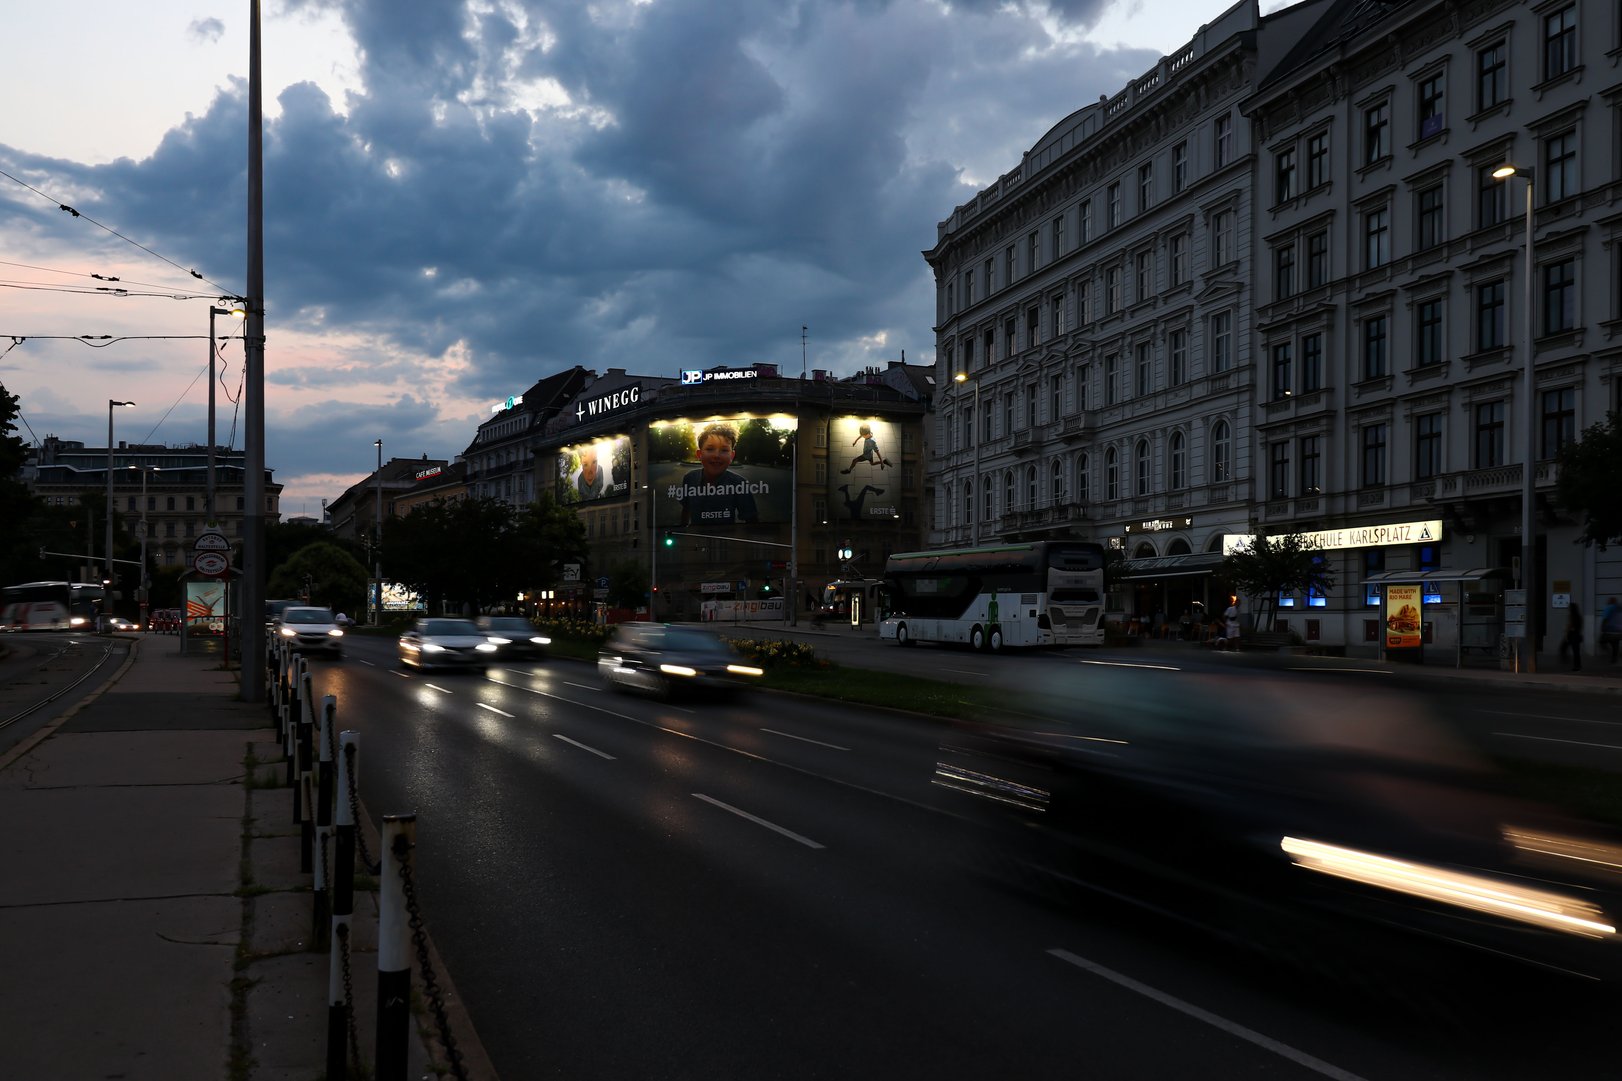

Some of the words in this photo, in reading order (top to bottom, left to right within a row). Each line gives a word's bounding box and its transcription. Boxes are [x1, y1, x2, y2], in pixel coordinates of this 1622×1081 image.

[702, 373, 713, 381] JP
[713, 370, 758, 380] IMMOBILIEN
[588, 386, 639, 416] WINEGG
[667, 480, 770, 501] #glaubandich
[701, 510, 722, 519] ERSTE
[870, 507, 890, 516] ERSTE
[1350, 525, 1411, 545] KARLSPLATZ
